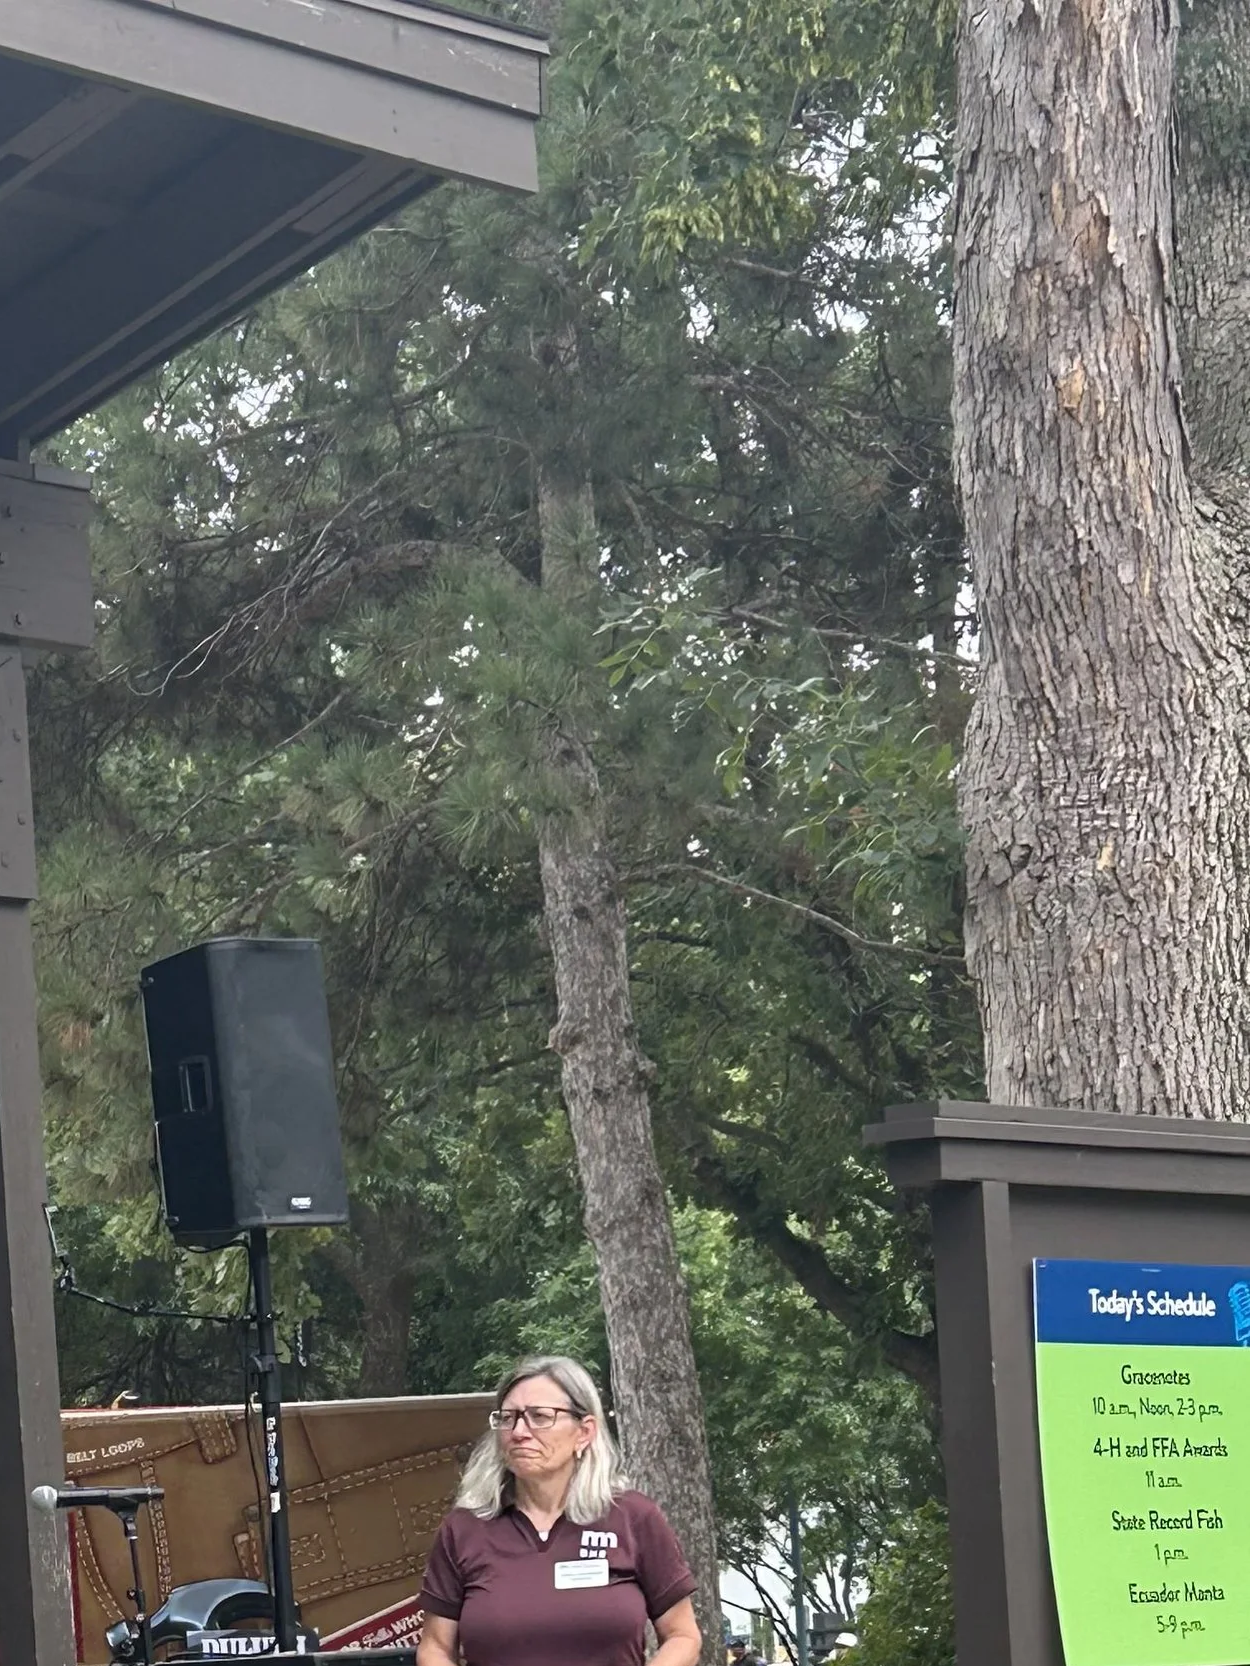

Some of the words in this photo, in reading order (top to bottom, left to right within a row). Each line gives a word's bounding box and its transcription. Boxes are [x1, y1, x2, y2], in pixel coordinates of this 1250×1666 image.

[1088, 1288, 1144, 1322] Today's
[1147, 1290, 1217, 1317] Schedule
[1092, 1397, 1106, 1415] 10
[1139, 1397, 1174, 1416] Noon,
[1176, 1398, 1195, 1416] 2-3
[1198, 1403, 1223, 1422] p.m.
[101, 1437, 145, 1458] LOOPS
[1093, 1437, 1121, 1457] 4-H
[1125, 1437, 1148, 1457] and
[1152, 1437, 1180, 1457] FFA
[1183, 1437, 1228, 1457] Awards
[1145, 1470, 1155, 1488] 11
[1112, 1510, 1146, 1530] State
[1149, 1509, 1193, 1530] Record
[1196, 1509, 1223, 1529] Fish
[1154, 1543, 1160, 1560] 1
[1184, 1581, 1225, 1602] Manta
[1156, 1615, 1177, 1633] 5-9
